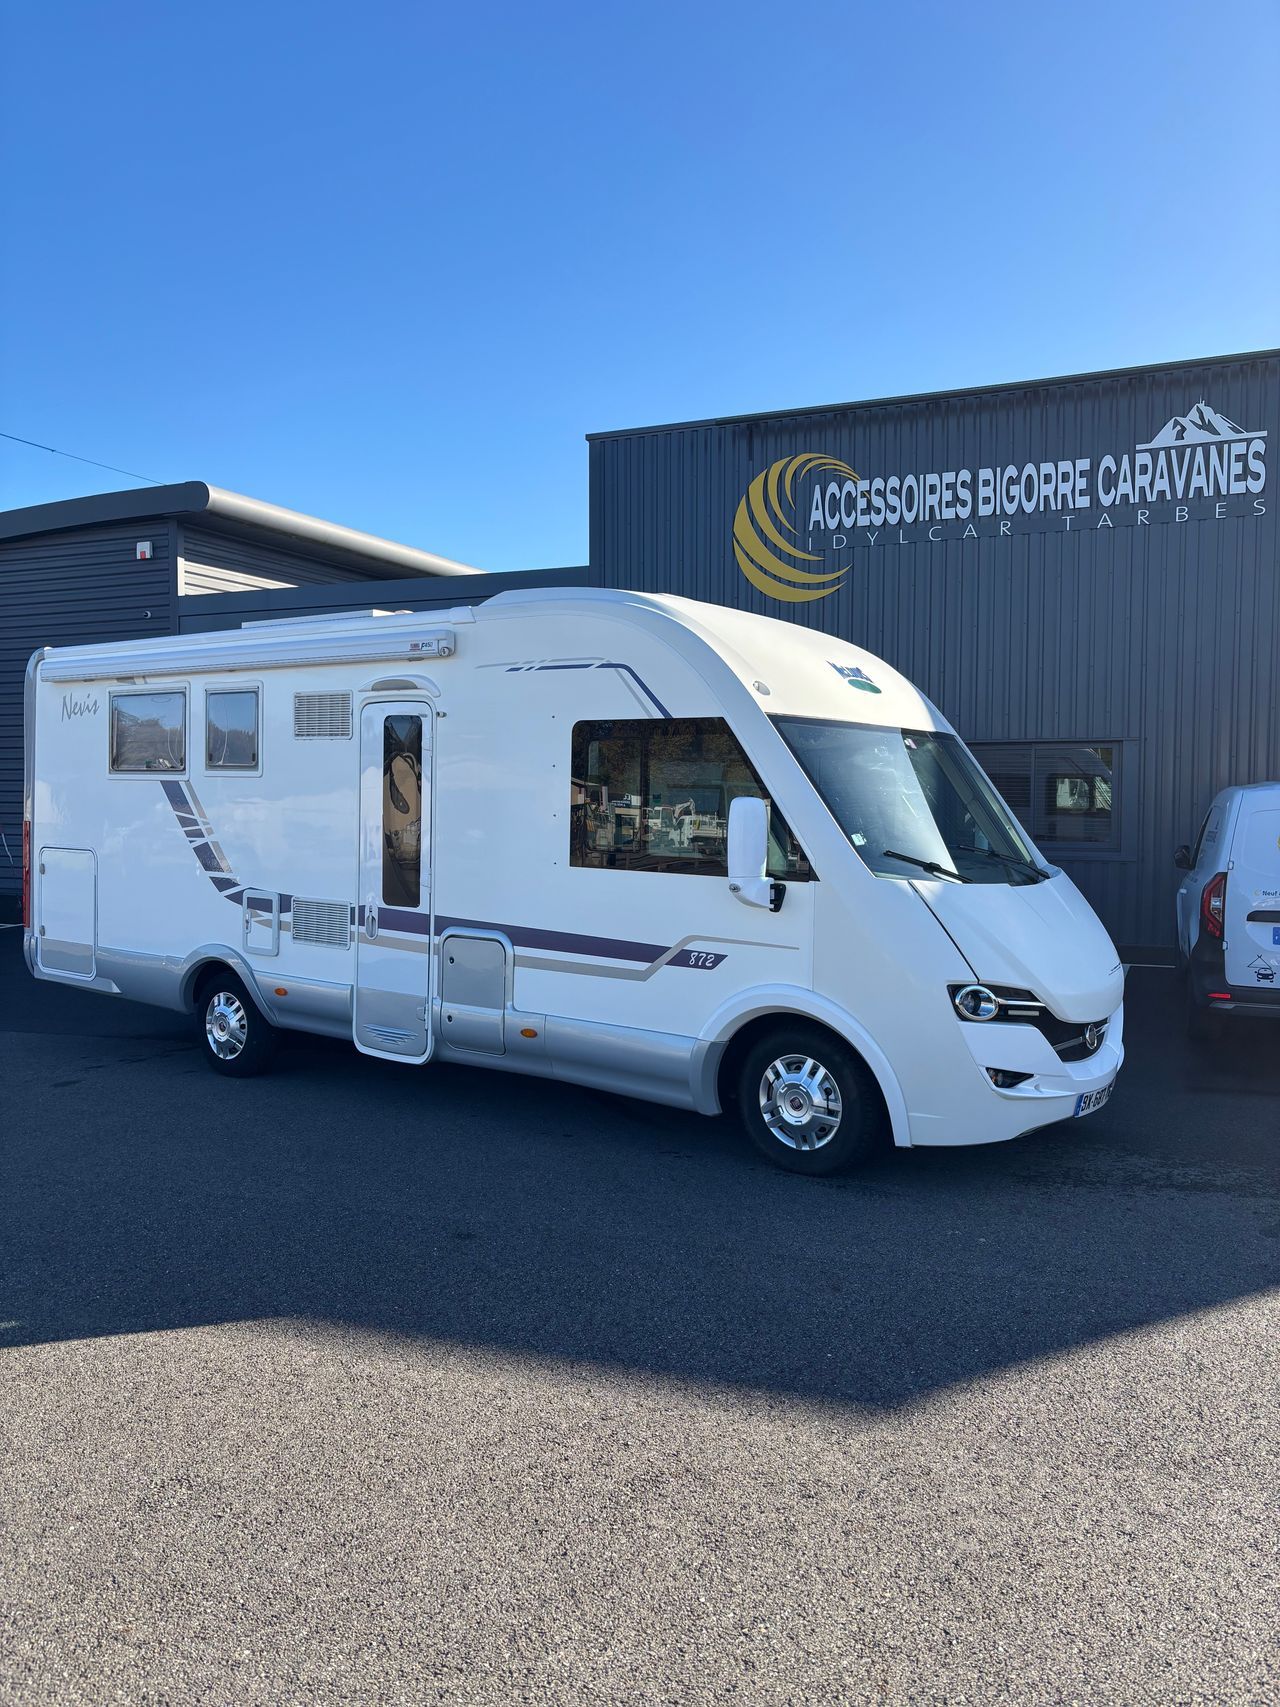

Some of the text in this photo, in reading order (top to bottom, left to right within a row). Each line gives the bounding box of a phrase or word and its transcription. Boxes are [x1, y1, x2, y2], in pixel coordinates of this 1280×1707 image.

[808, 438, 1267, 531] ACCESSOIRES BIGORRE CARAVANES
[808, 498, 1266, 551] IDYLCAR TARBES
[61, 692, 100, 723] Nevis
[689, 952, 715, 967] 872
